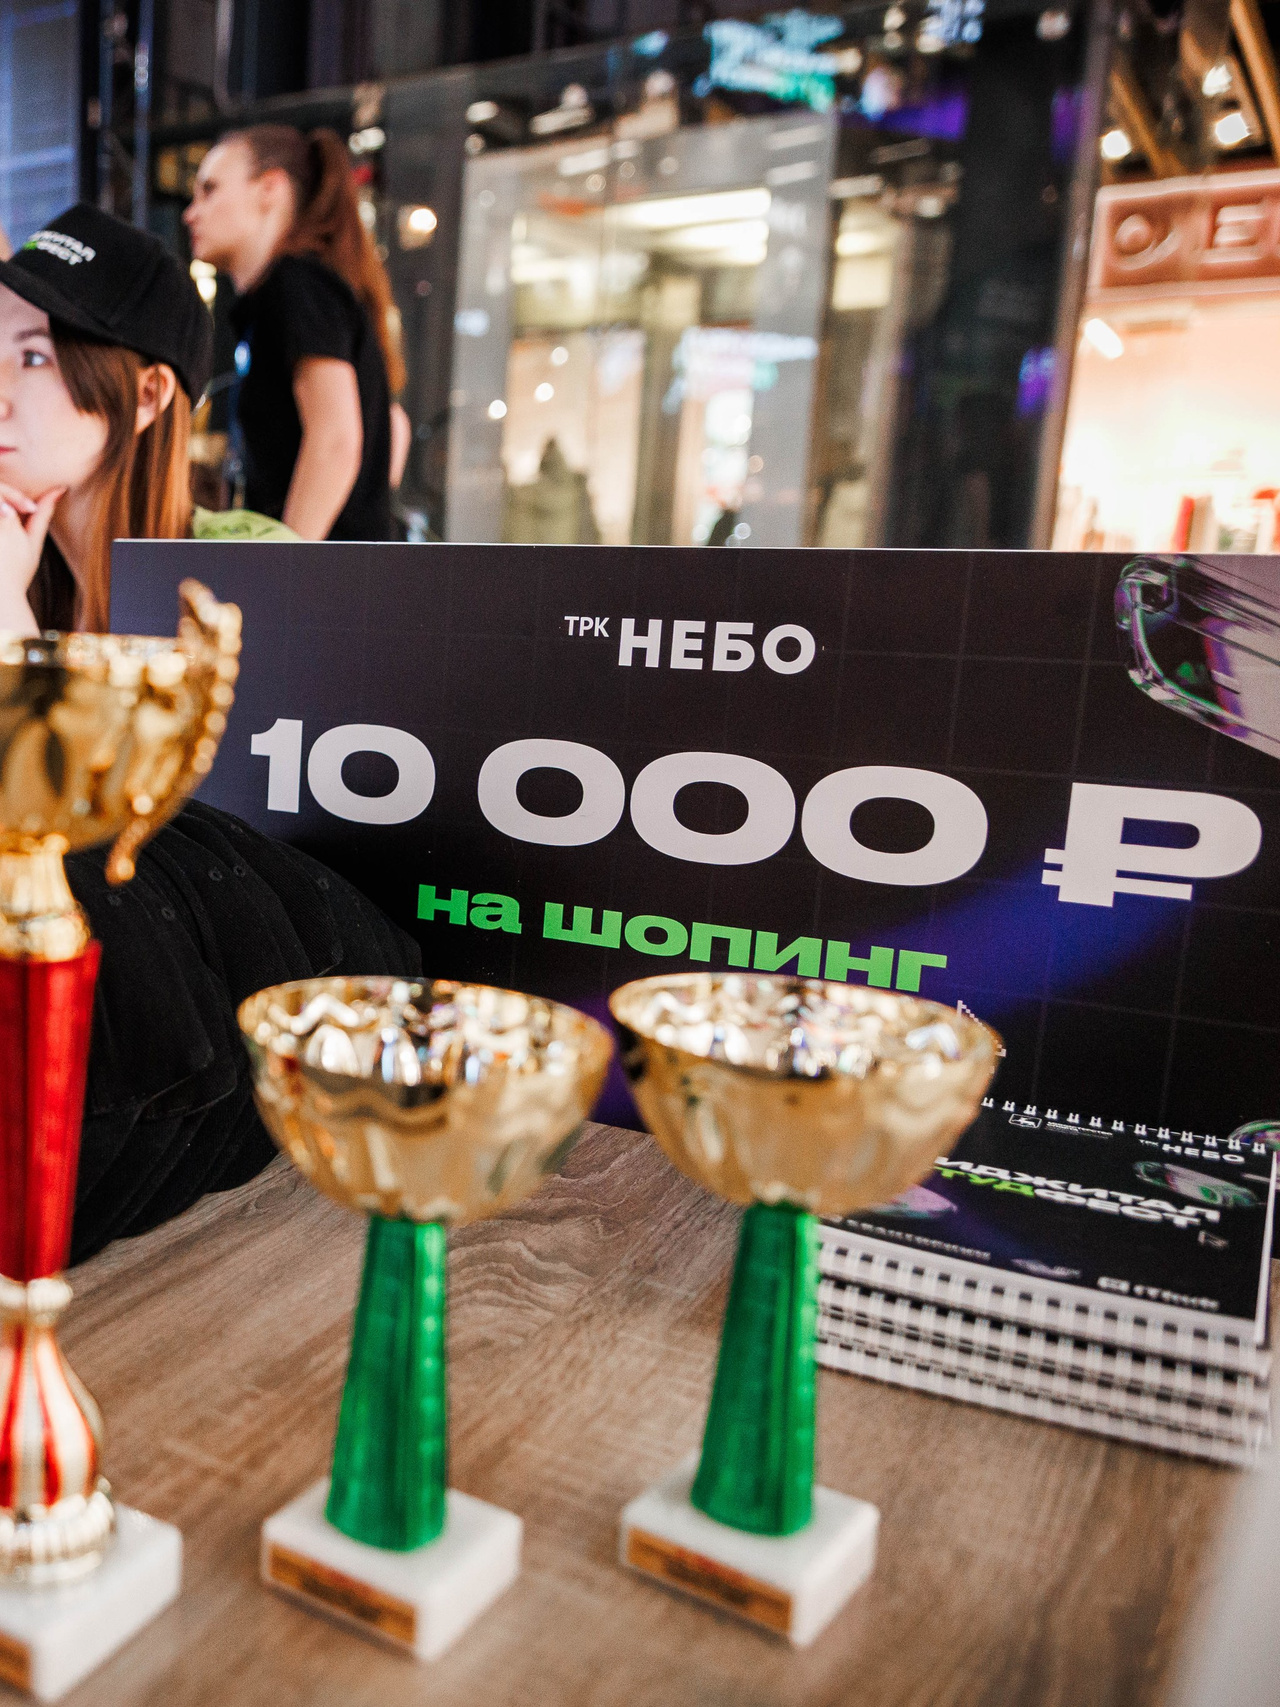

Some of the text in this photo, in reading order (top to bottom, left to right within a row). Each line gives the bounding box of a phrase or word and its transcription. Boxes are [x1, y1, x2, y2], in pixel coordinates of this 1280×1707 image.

[564, 616, 816, 674] ТРК НЕБО
[250, 718, 436, 825] 10
[477, 738, 988, 886] 000
[417, 884, 948, 992] на шопинг
[1162, 1143, 1245, 1162] НЕБО
[933, 1165, 1202, 1230] ТУДФЕСТ
[934, 1156, 1220, 1224] ИДЖИТАЛ
